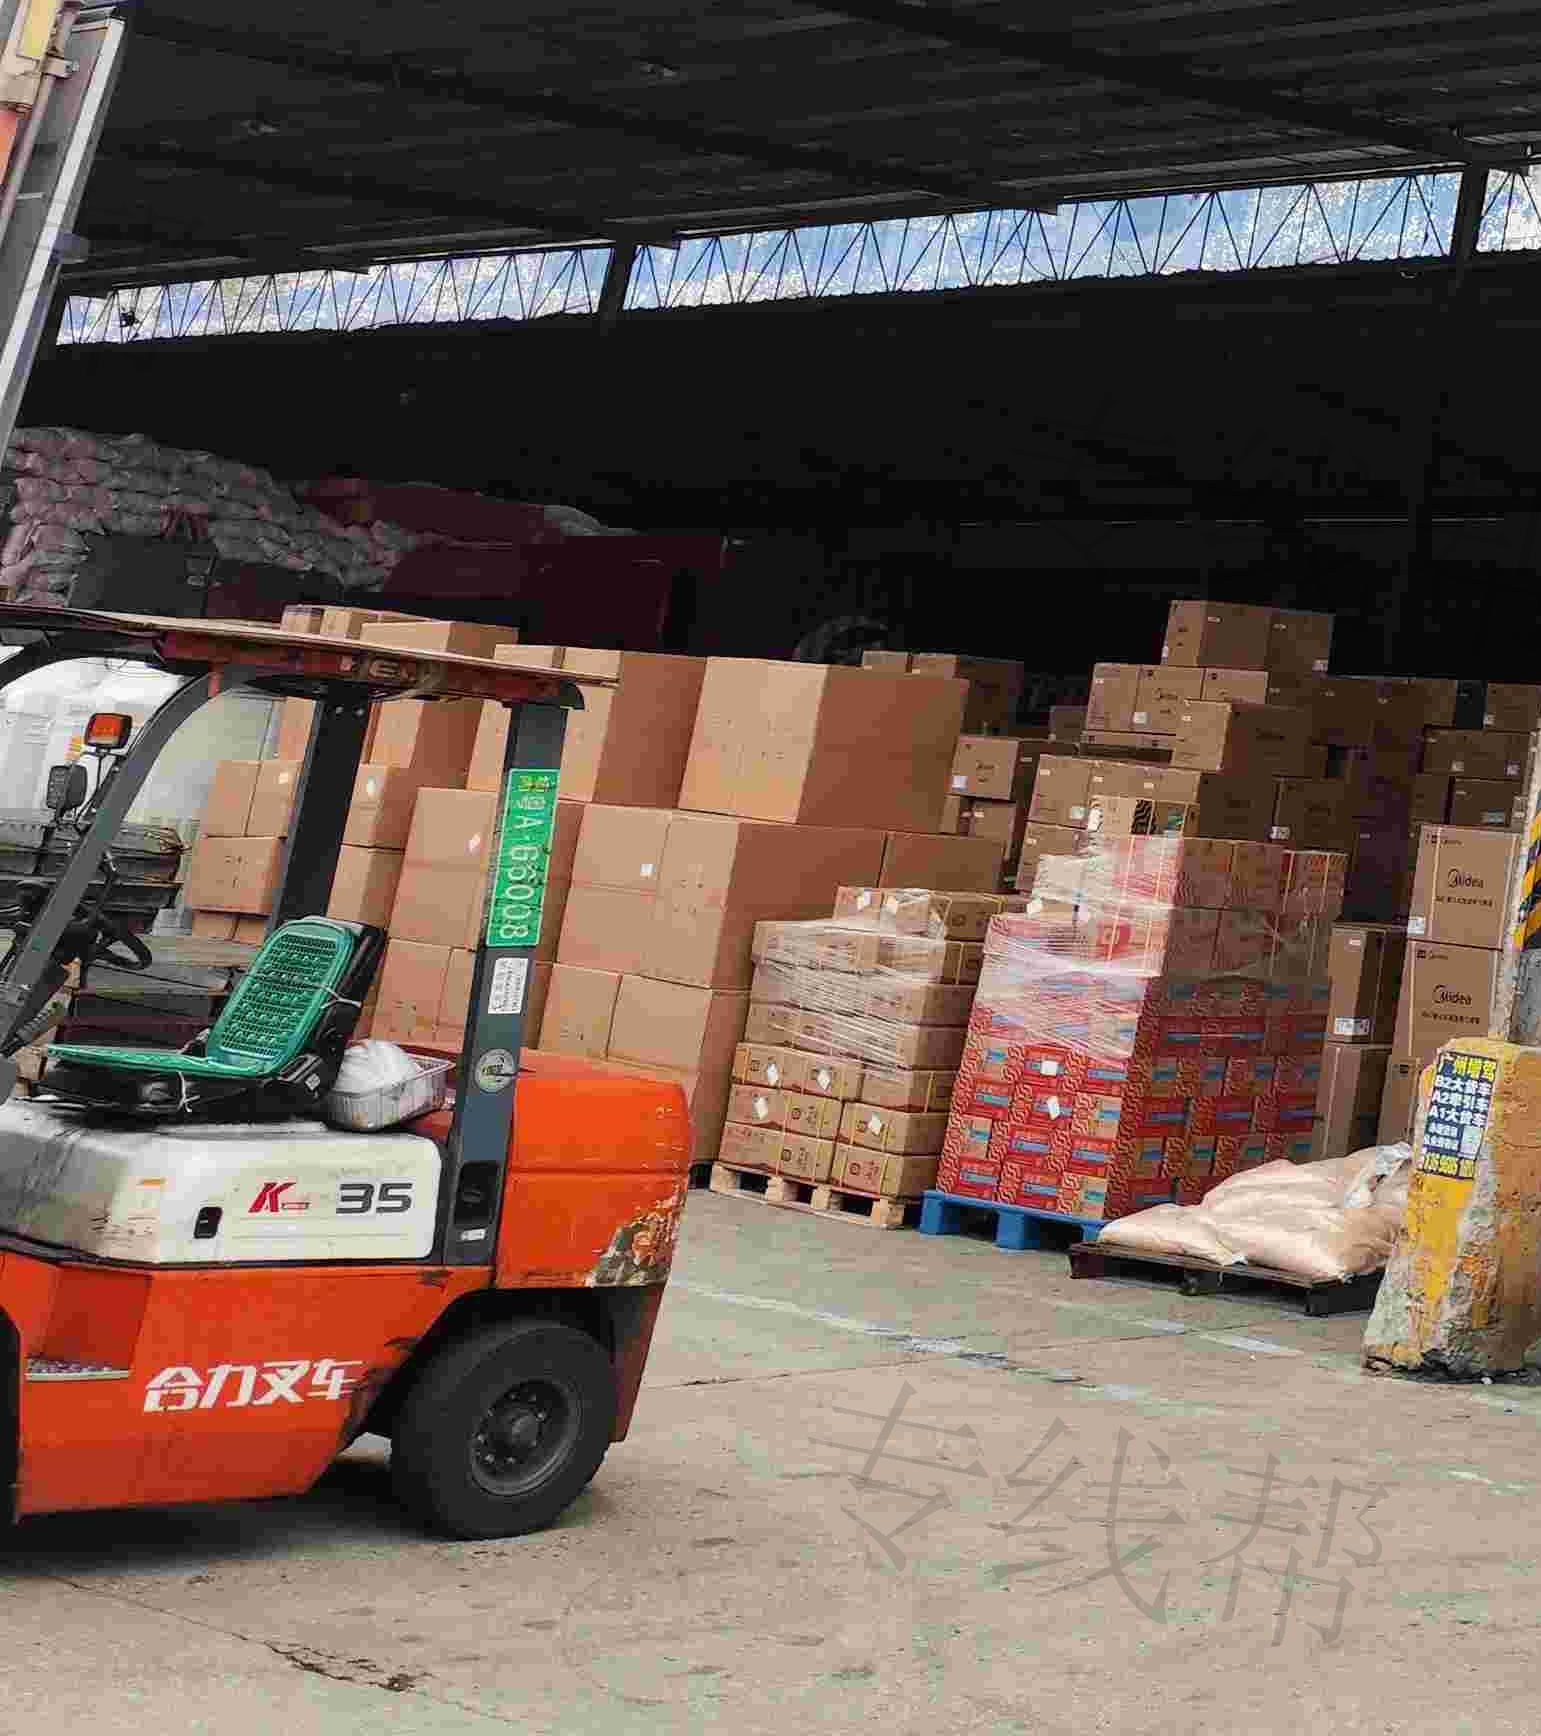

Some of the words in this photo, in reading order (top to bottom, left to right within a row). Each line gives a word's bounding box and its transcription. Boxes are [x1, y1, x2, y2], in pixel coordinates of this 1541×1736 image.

[1448, 868, 1484, 889] Midea
[1433, 984, 1472, 1006] Midea
[336, 1183, 413, 1214] 35
[143, 1359, 363, 1413] 合力叉车
